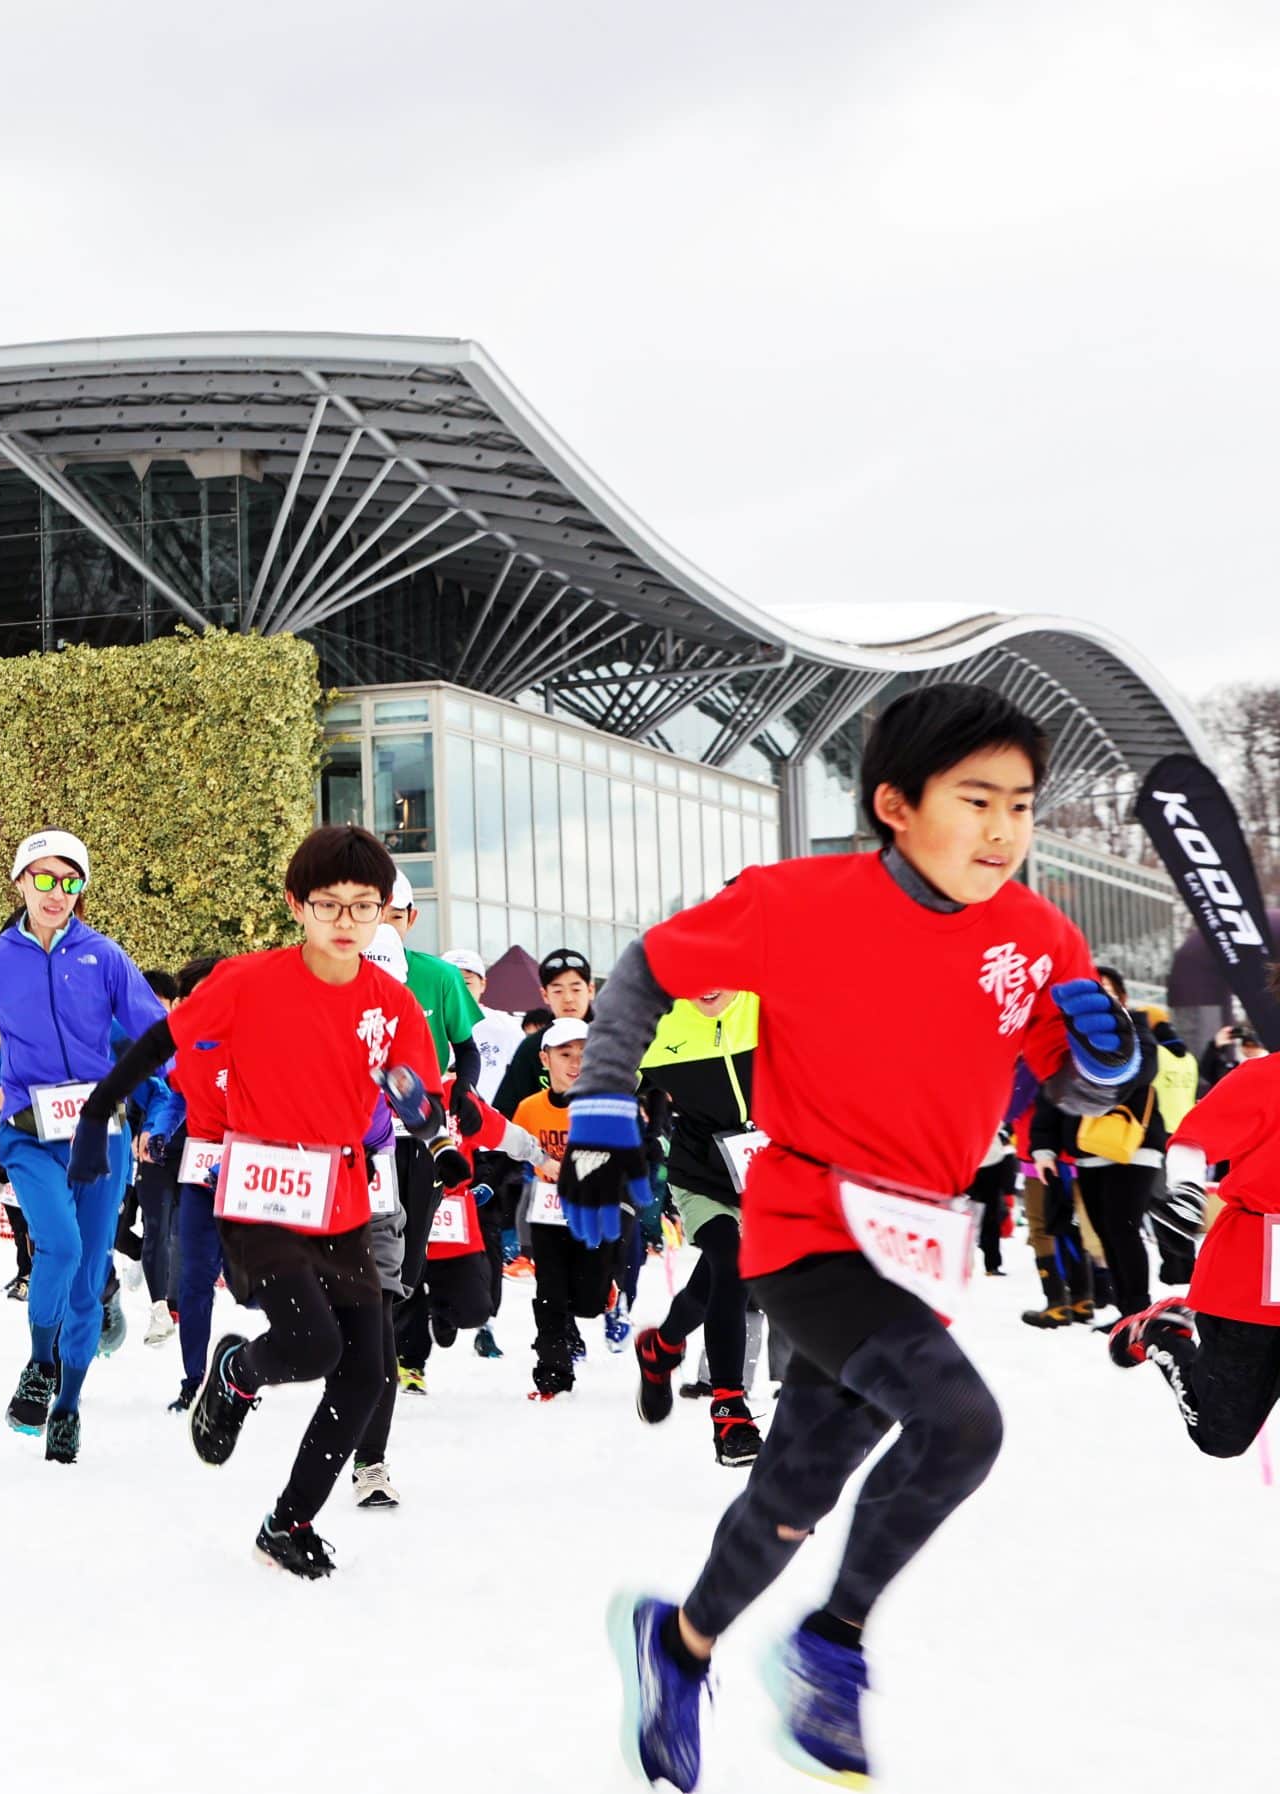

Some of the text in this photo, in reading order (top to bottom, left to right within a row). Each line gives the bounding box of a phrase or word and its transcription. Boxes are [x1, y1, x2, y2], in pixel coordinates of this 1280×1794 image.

[1152, 790, 1263, 945] KODA
[1184, 871, 1205, 897] EAT
[1200, 899, 1221, 930] THE
[243, 1163, 312, 1198] 3055
